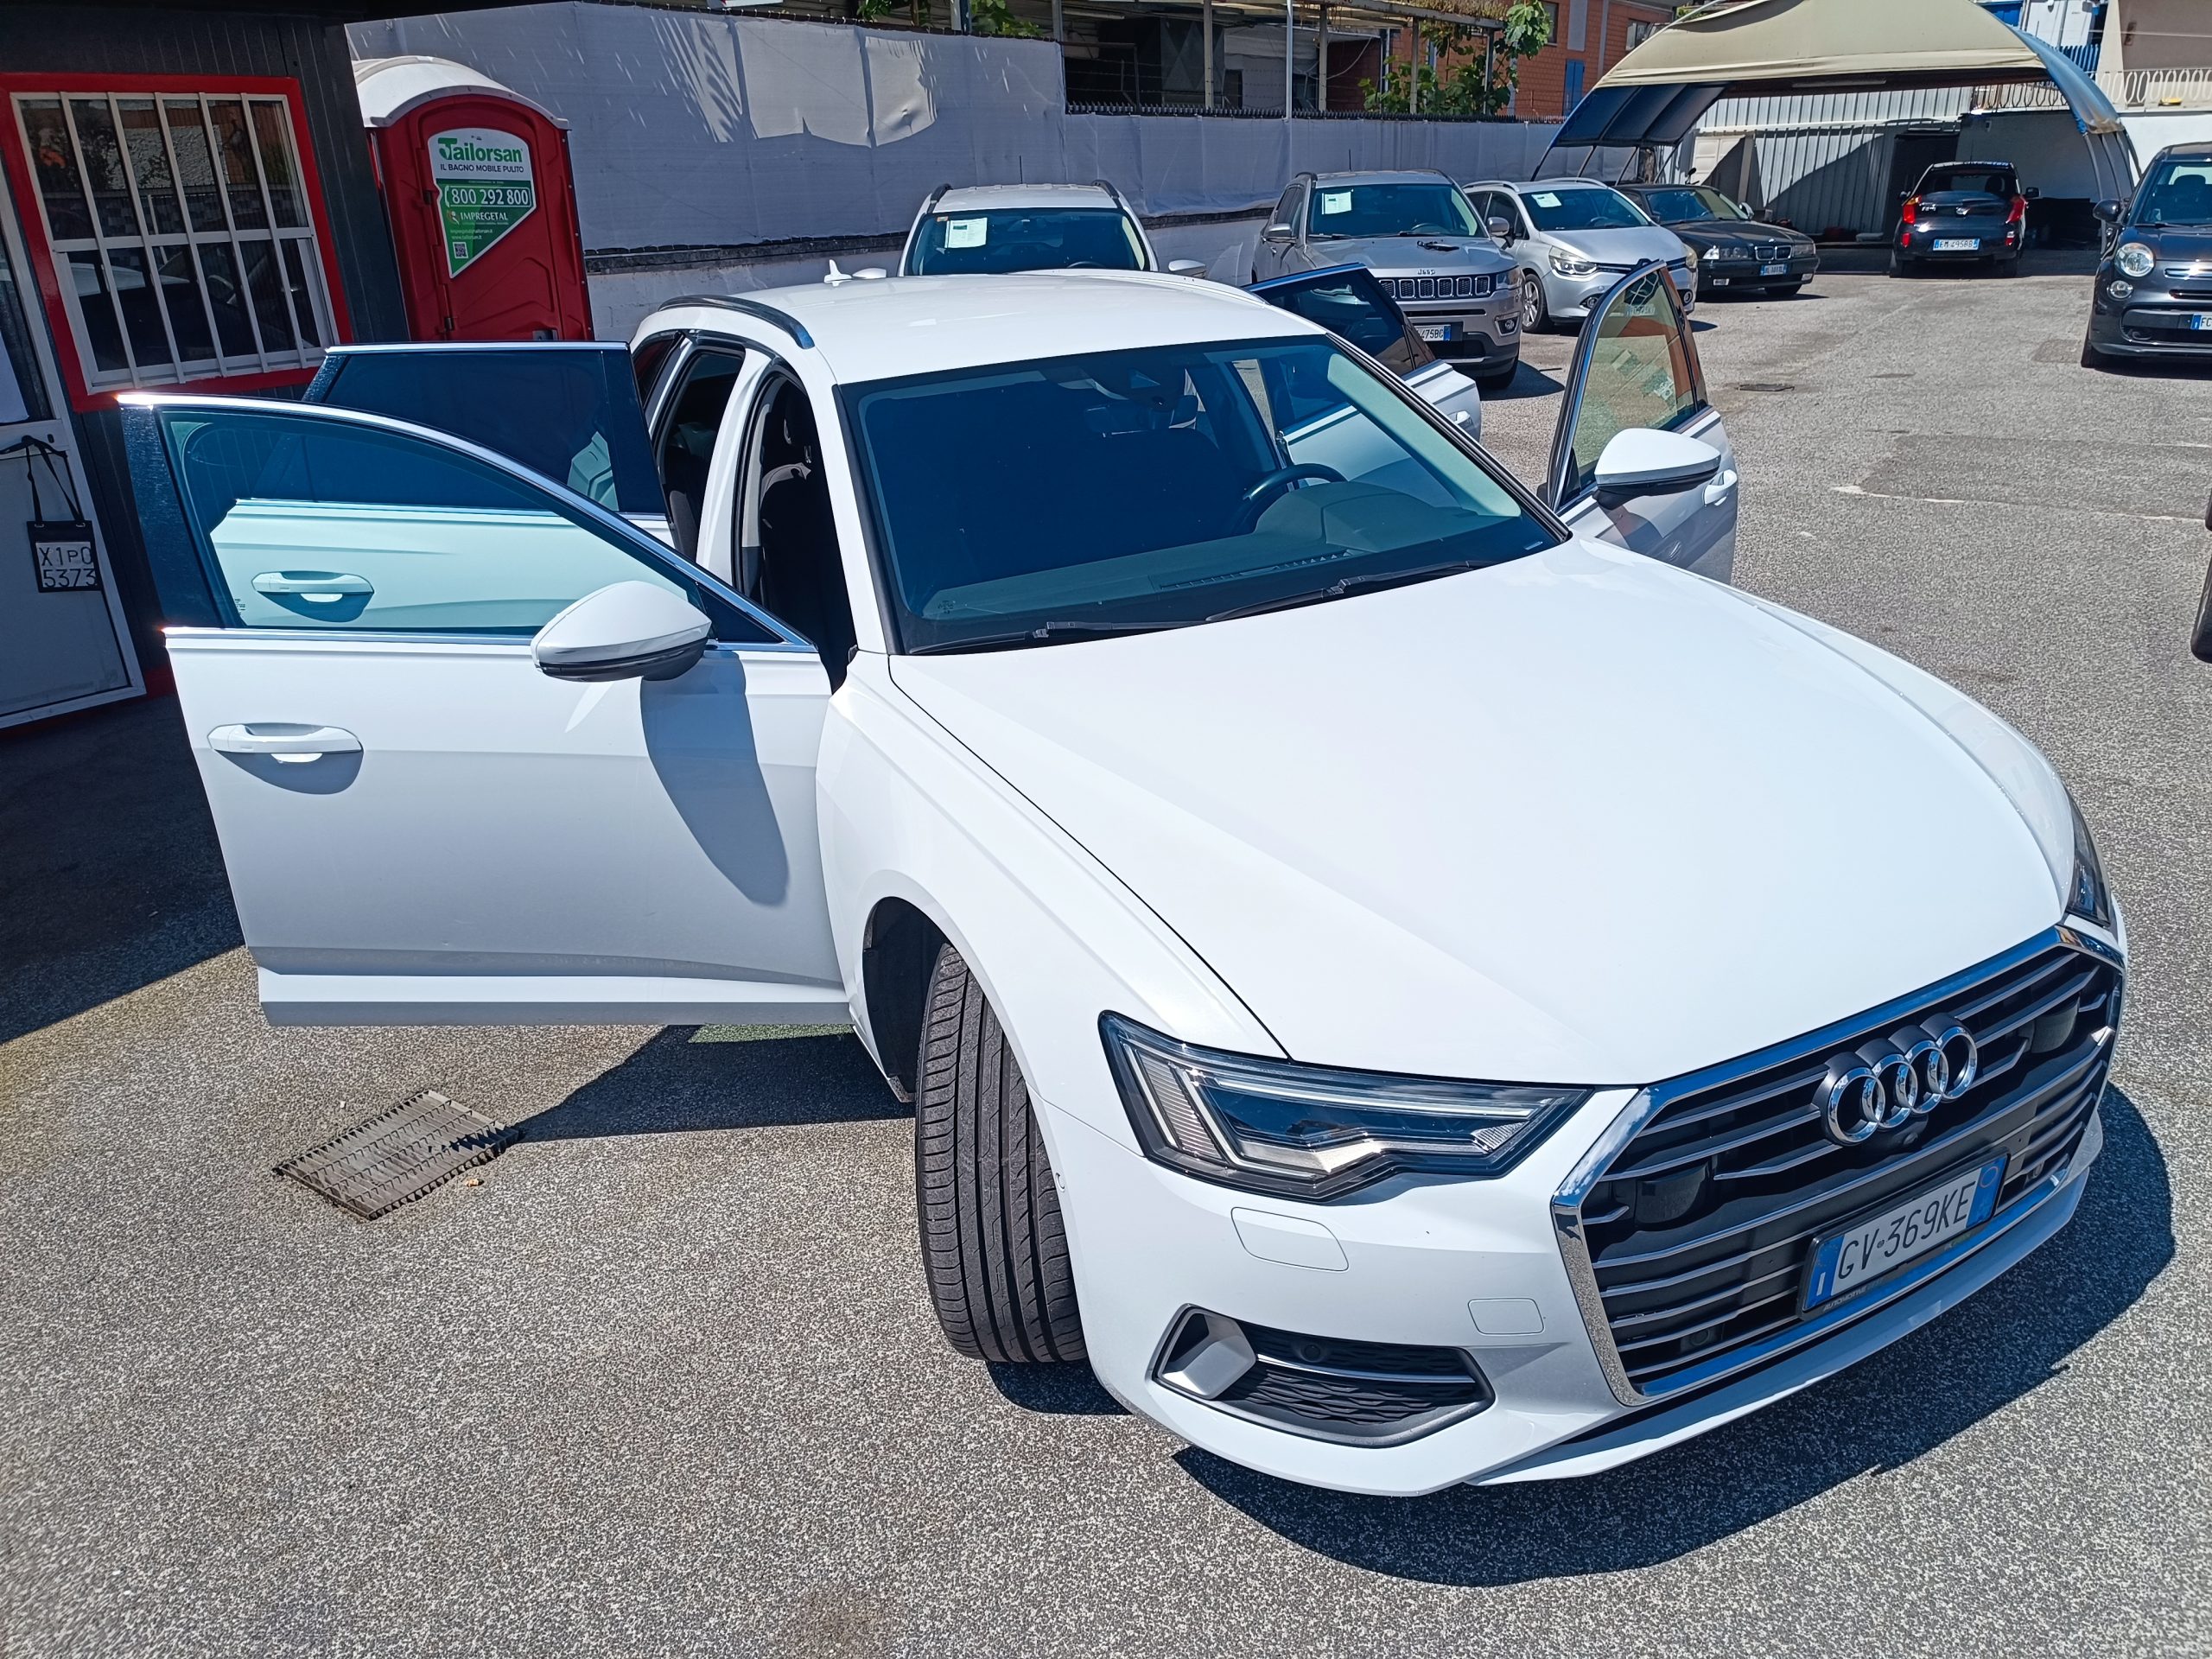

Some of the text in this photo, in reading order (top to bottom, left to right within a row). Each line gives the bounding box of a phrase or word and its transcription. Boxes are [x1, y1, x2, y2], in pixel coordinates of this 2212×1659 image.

[437, 137, 523, 162] Tailorsan
[448, 163, 474, 172] BAGNO
[475, 164, 501, 173] MOBILE
[451, 188, 529, 205] 800 292 800
[460, 212, 509, 220] IMPREGETAL
[43, 568, 97, 588] 5373
